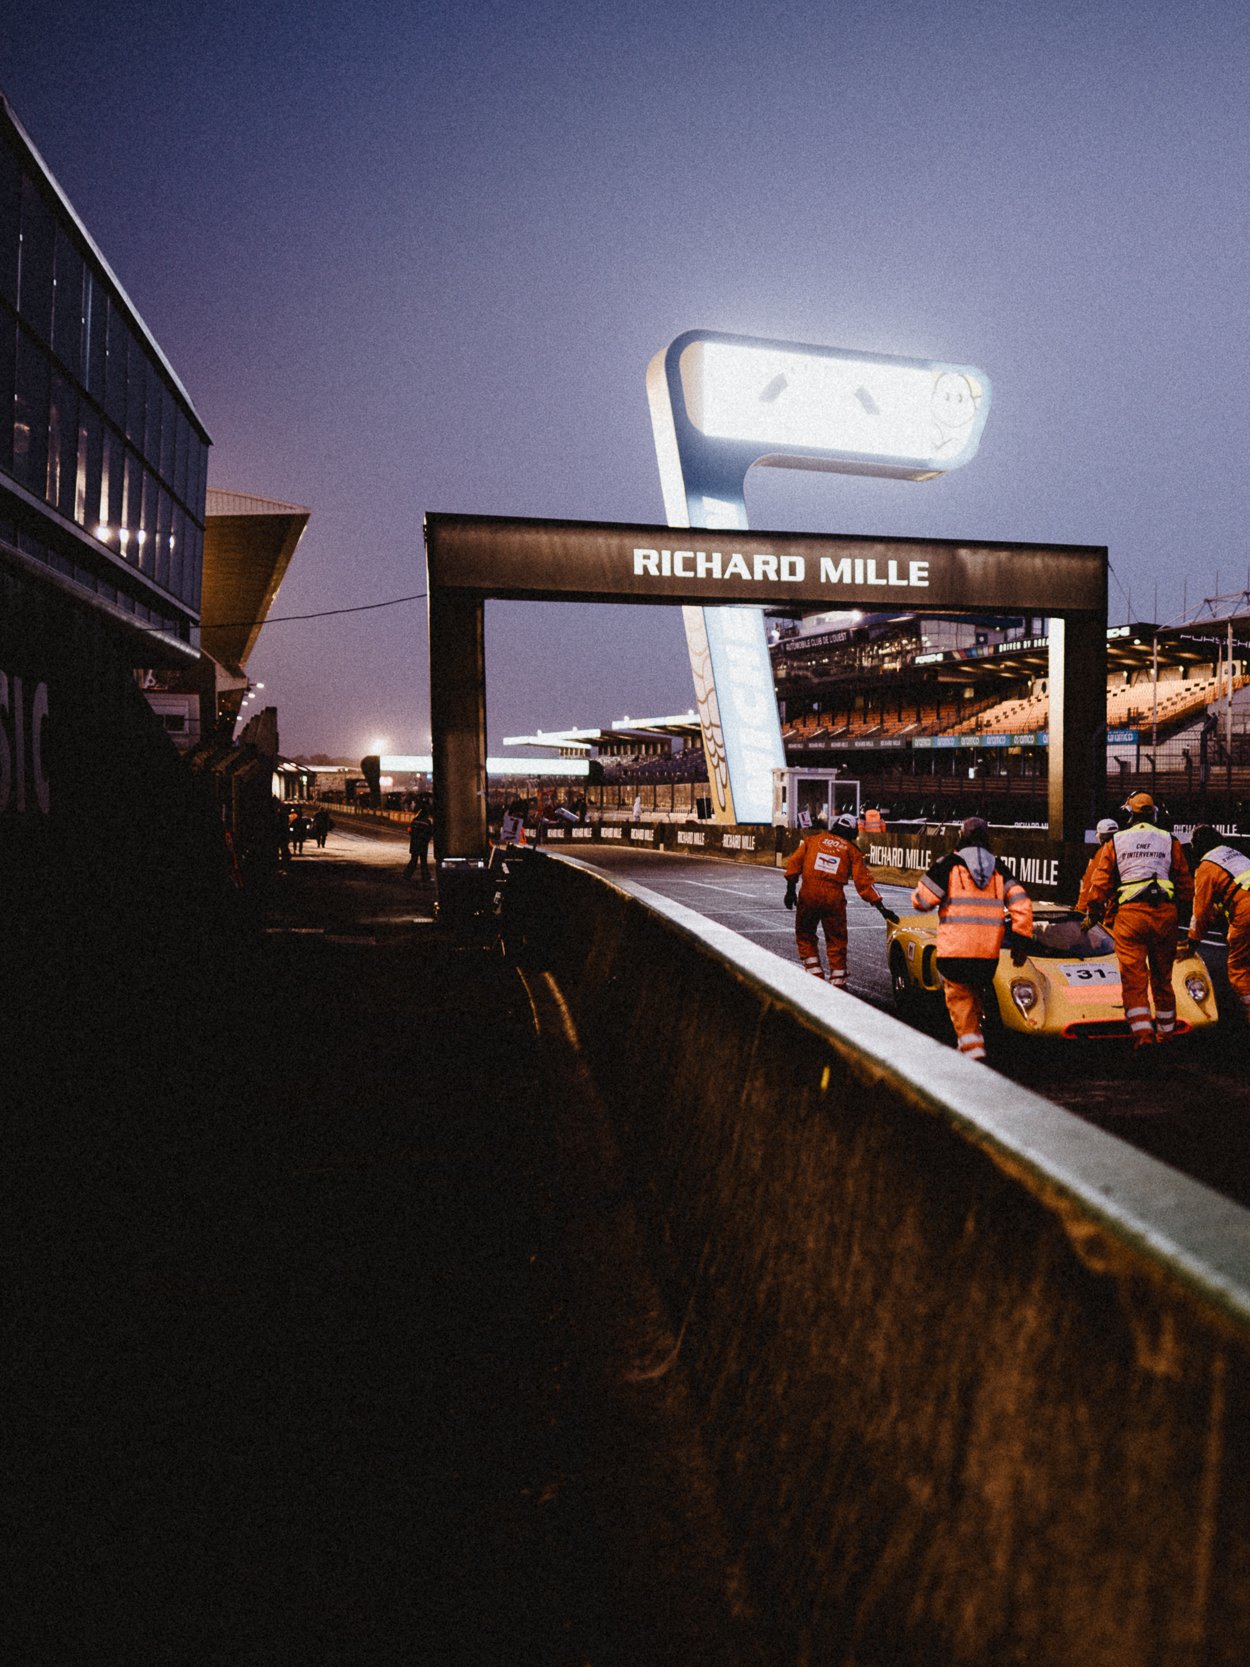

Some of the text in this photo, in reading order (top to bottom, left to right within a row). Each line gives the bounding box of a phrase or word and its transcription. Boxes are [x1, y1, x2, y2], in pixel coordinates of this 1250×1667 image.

[632, 548, 930, 587] RICHARD MILLE
[810, 637, 822, 647] CLUB
[822, 635, 829, 644] DE
[1023, 639, 1031, 649] BY
[1013, 734, 1035, 744] aramco
[869, 844, 932, 871] RICHARD MILLE
[1019, 857, 1059, 886] MILLE
[1076, 968, 1106, 980] 31
